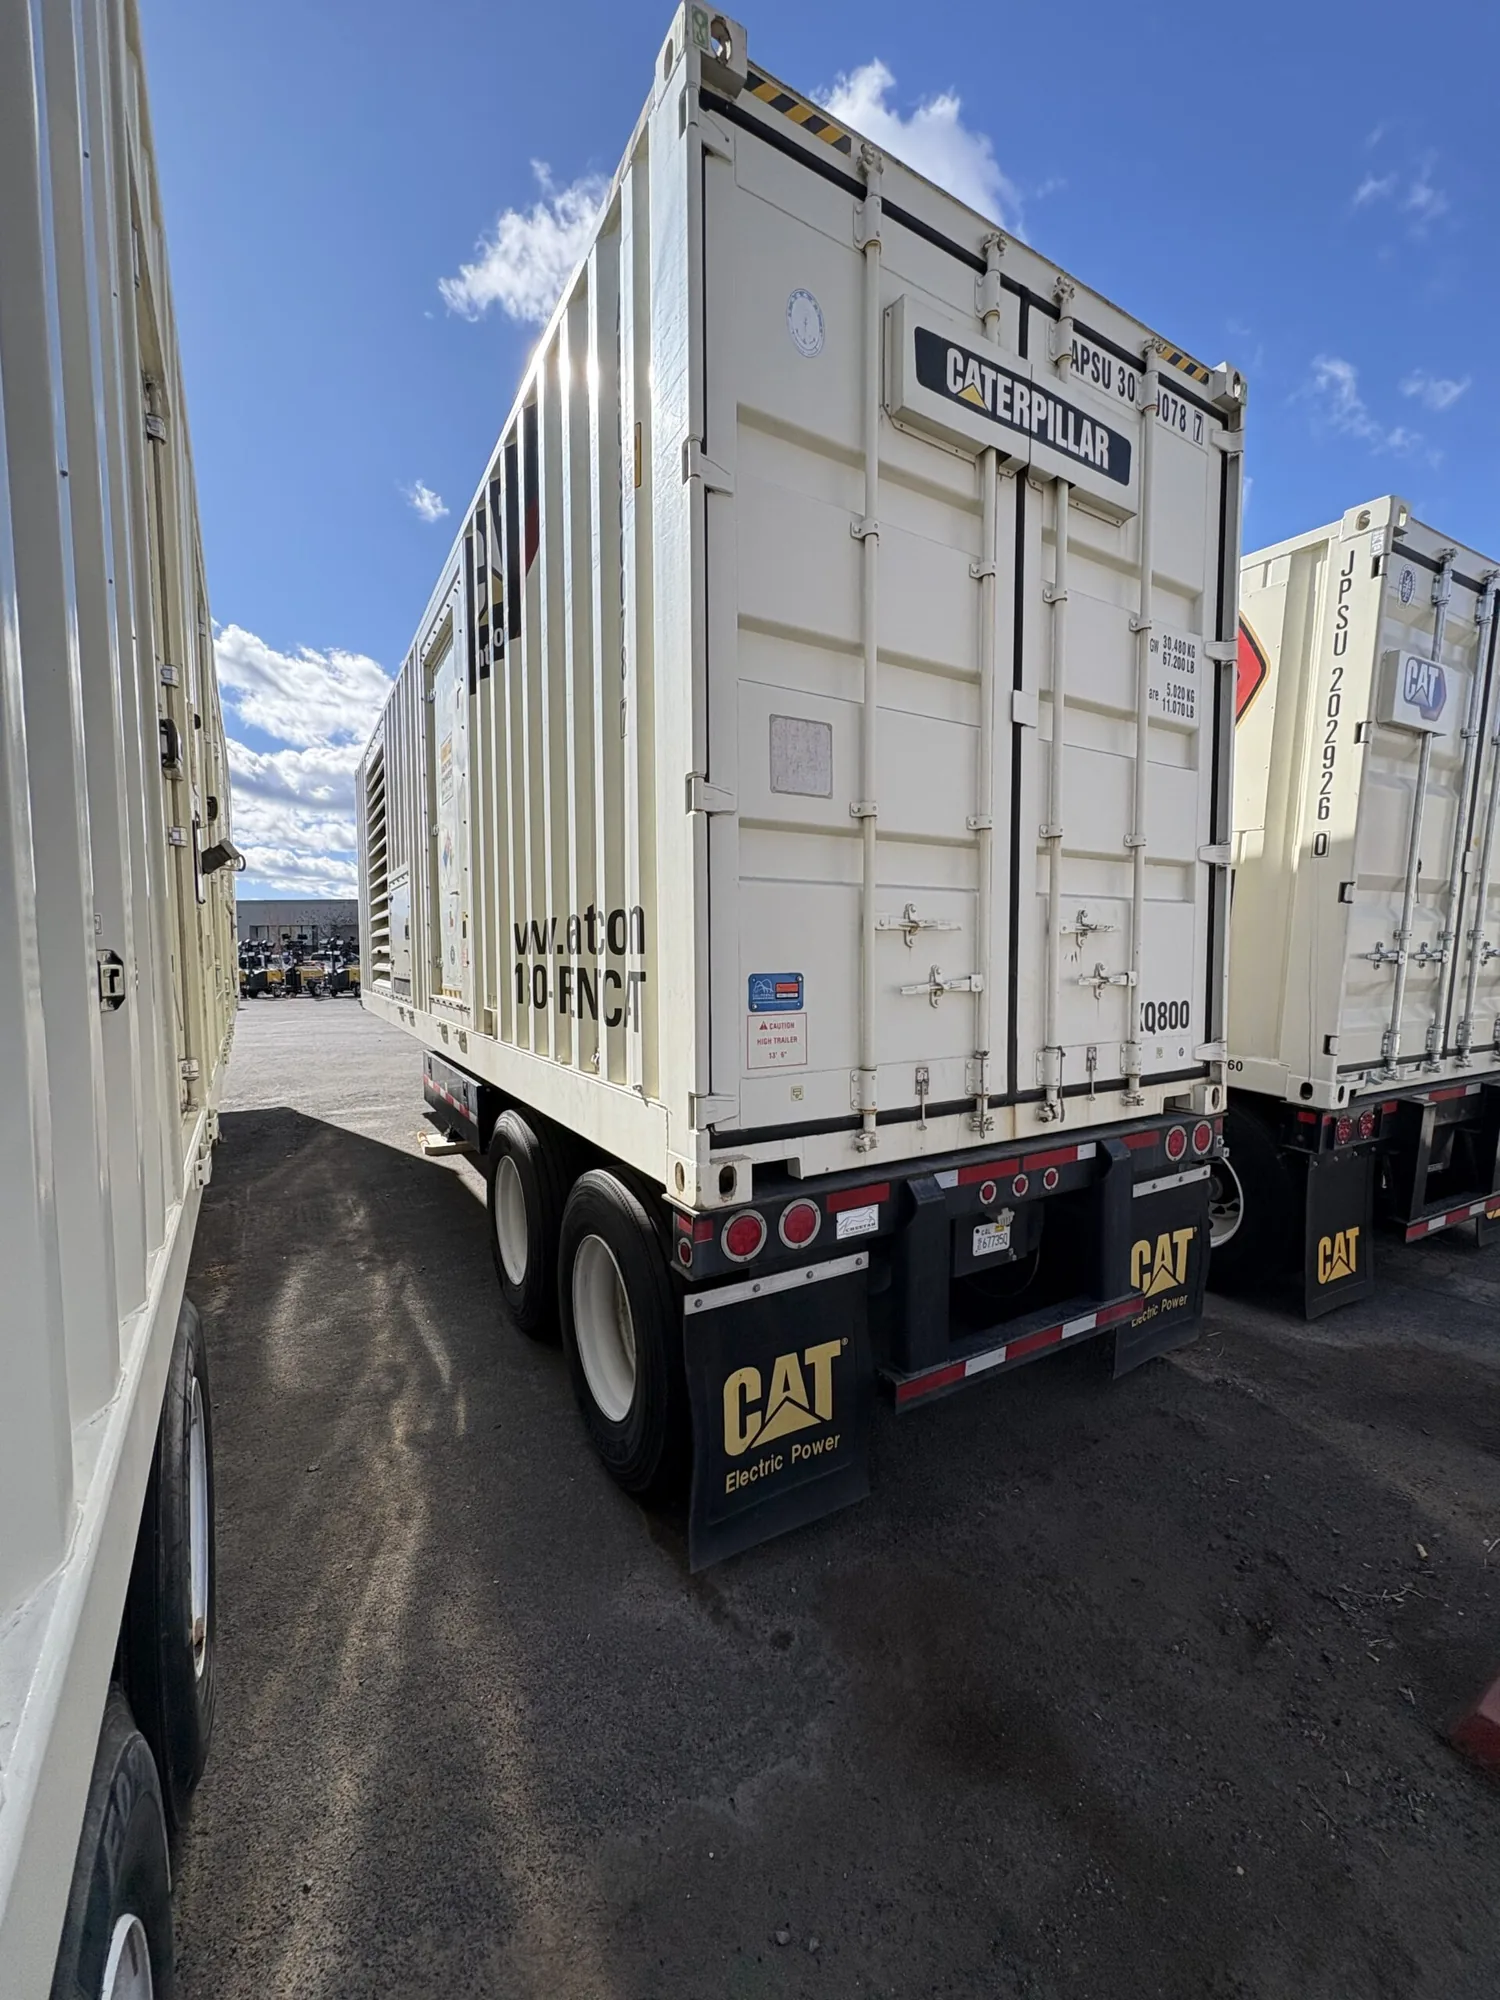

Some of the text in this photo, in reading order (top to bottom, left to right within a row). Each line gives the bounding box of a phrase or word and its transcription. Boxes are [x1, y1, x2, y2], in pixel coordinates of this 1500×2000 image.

[1070, 338, 1111, 390] APSU
[946, 347, 1110, 470] CATERPILLAR
[1186, 659, 1195, 674] LB
[1187, 643, 1195, 658] KG
[1149, 688, 1159, 701] are
[1187, 688, 1195, 703] KG
[1404, 659, 1439, 707] CAT
[1186, 704, 1194, 718] LB
[1314, 549, 1355, 857] JPSU 202926 0
[757, 1035, 798, 1045] HIGH TRAILER
[769, 1021, 795, 1030] CAUTION
[1227, 1059, 1243, 1071] 60
[1130, 1227, 1194, 1297] CAT
[1317, 1226, 1360, 1285] CAT
[1161, 1294, 1188, 1313] Power
[723, 1339, 841, 1457] CAT
[725, 1432, 841, 1494] Electric Power
